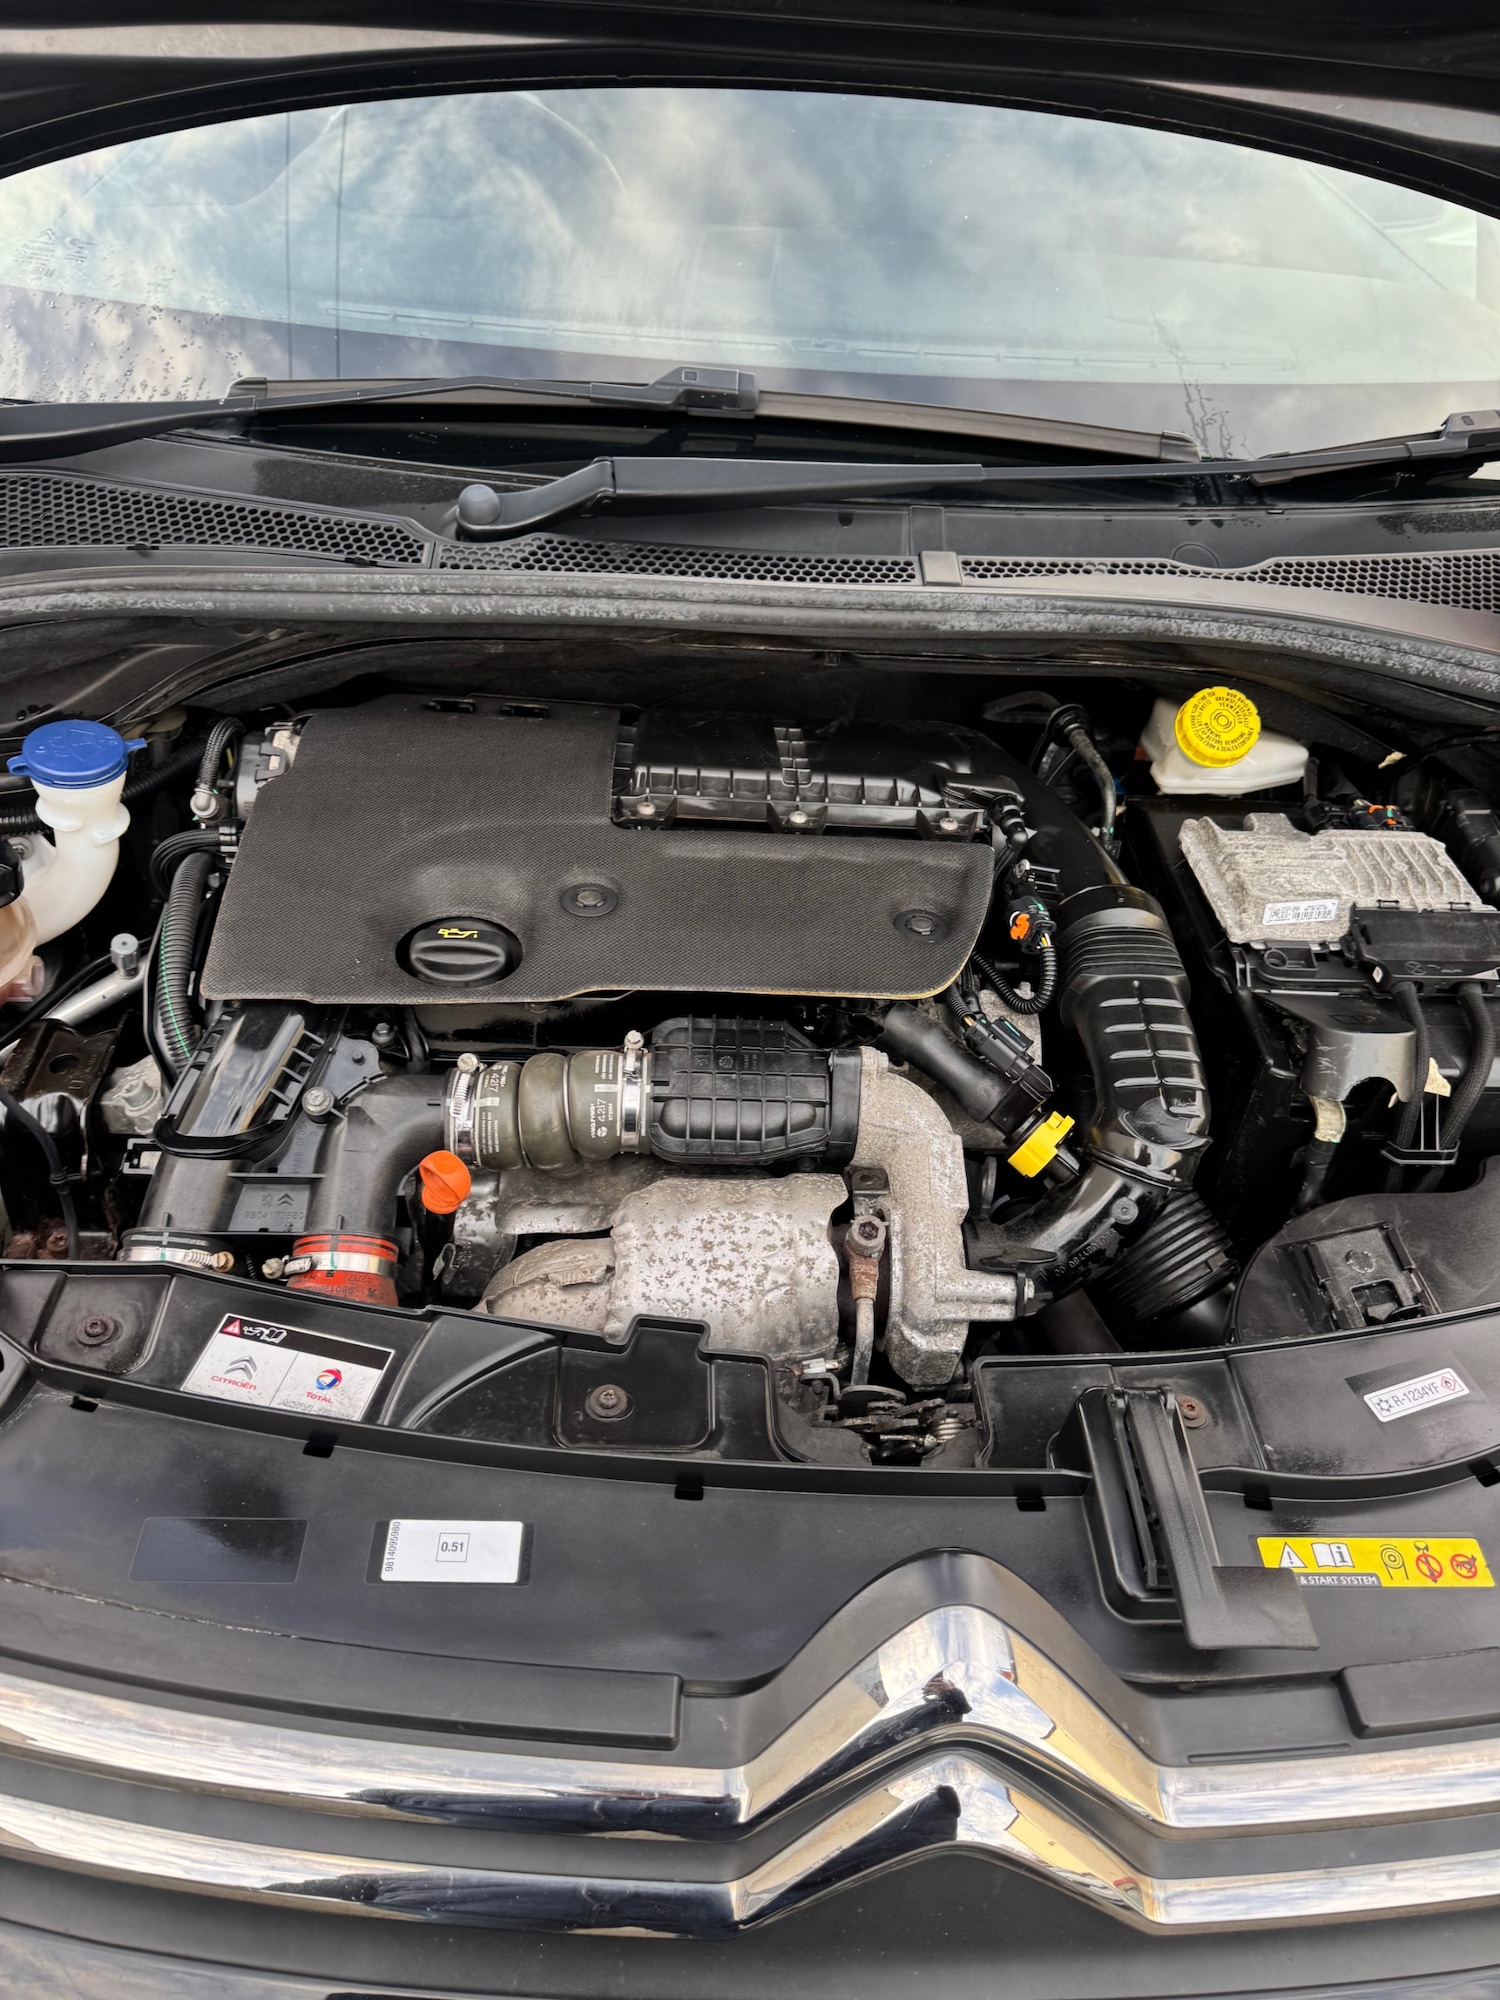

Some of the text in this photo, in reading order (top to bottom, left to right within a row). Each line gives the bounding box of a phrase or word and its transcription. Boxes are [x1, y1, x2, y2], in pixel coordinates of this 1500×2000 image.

[306, 1391, 333, 1404] TOTAL
[1391, 1381, 1440, 1407] R-1234YF
[385, 1521, 401, 1572] 9814095980
[441, 1541, 464, 1552] 0.51
[1300, 1576, 1308, 1584] &
[1308, 1575, 1338, 1584] START
[1339, 1575, 1378, 1584] SYSTEM
